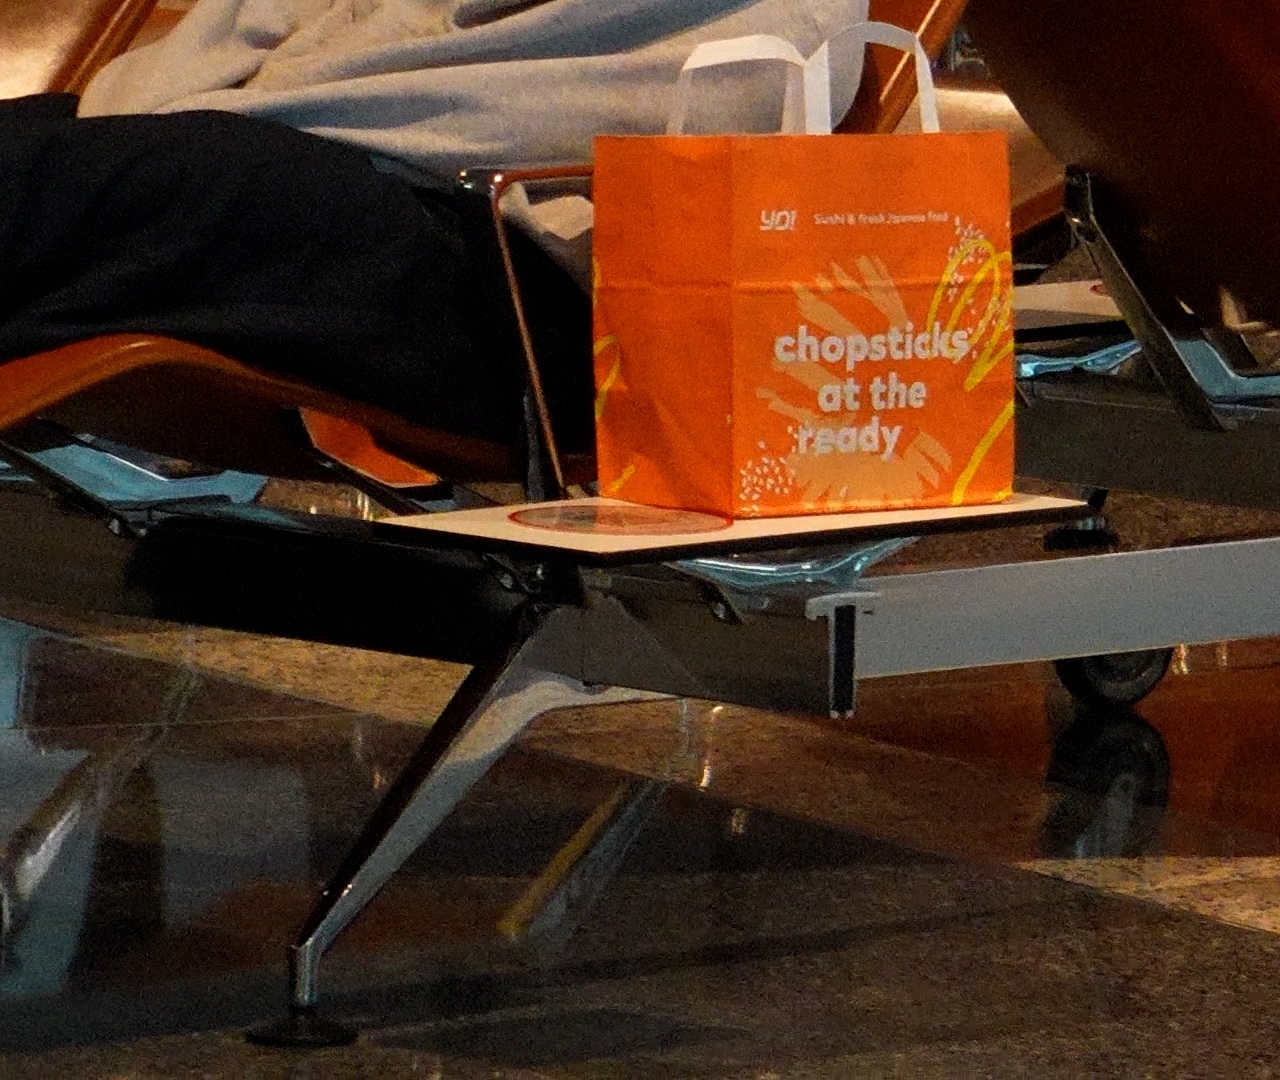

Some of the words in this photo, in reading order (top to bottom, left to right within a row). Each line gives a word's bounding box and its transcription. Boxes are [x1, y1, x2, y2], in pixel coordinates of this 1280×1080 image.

[775, 322, 970, 371] chopsticks
[819, 377, 860, 411] at
[871, 372, 927, 410] the
[799, 416, 902, 461] ready
